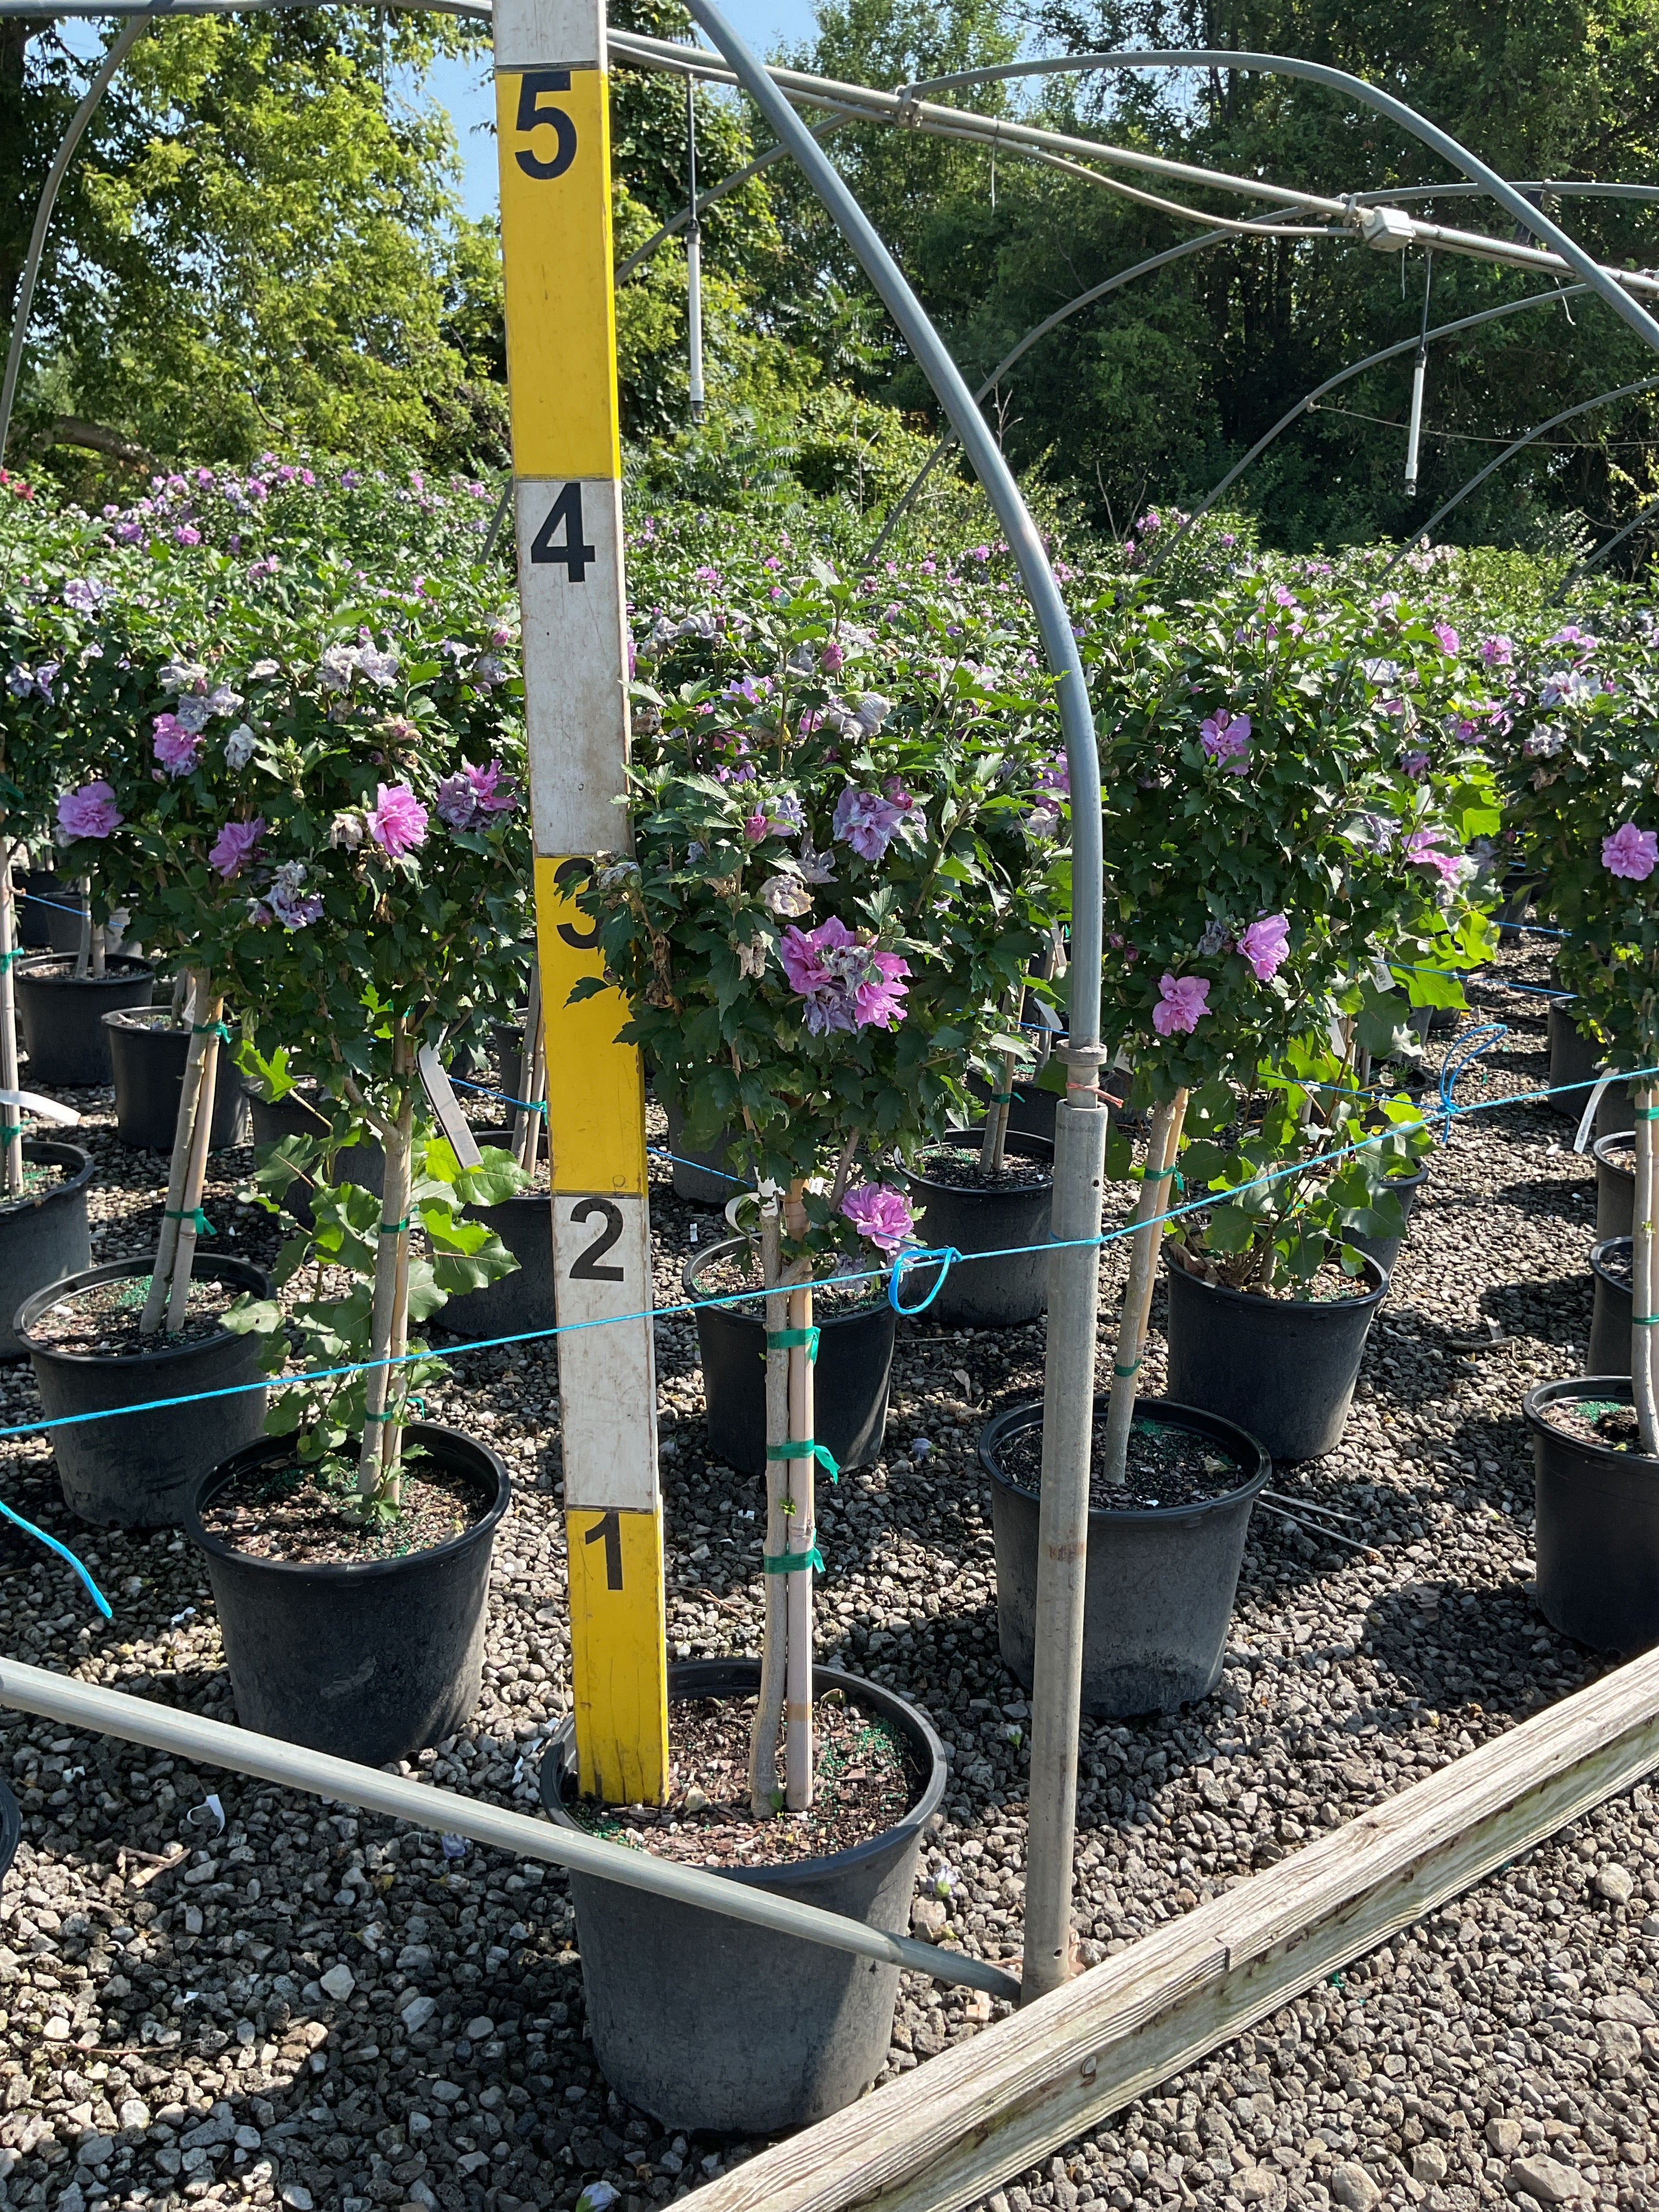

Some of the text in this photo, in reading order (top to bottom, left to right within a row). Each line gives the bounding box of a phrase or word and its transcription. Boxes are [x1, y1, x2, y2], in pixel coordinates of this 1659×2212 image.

[515, 71, 577, 179] 5
[531, 482, 595, 583] 4
[554, 858, 606, 949] 3
[569, 1198, 624, 1282] 2
[585, 1513, 624, 1590] 1
